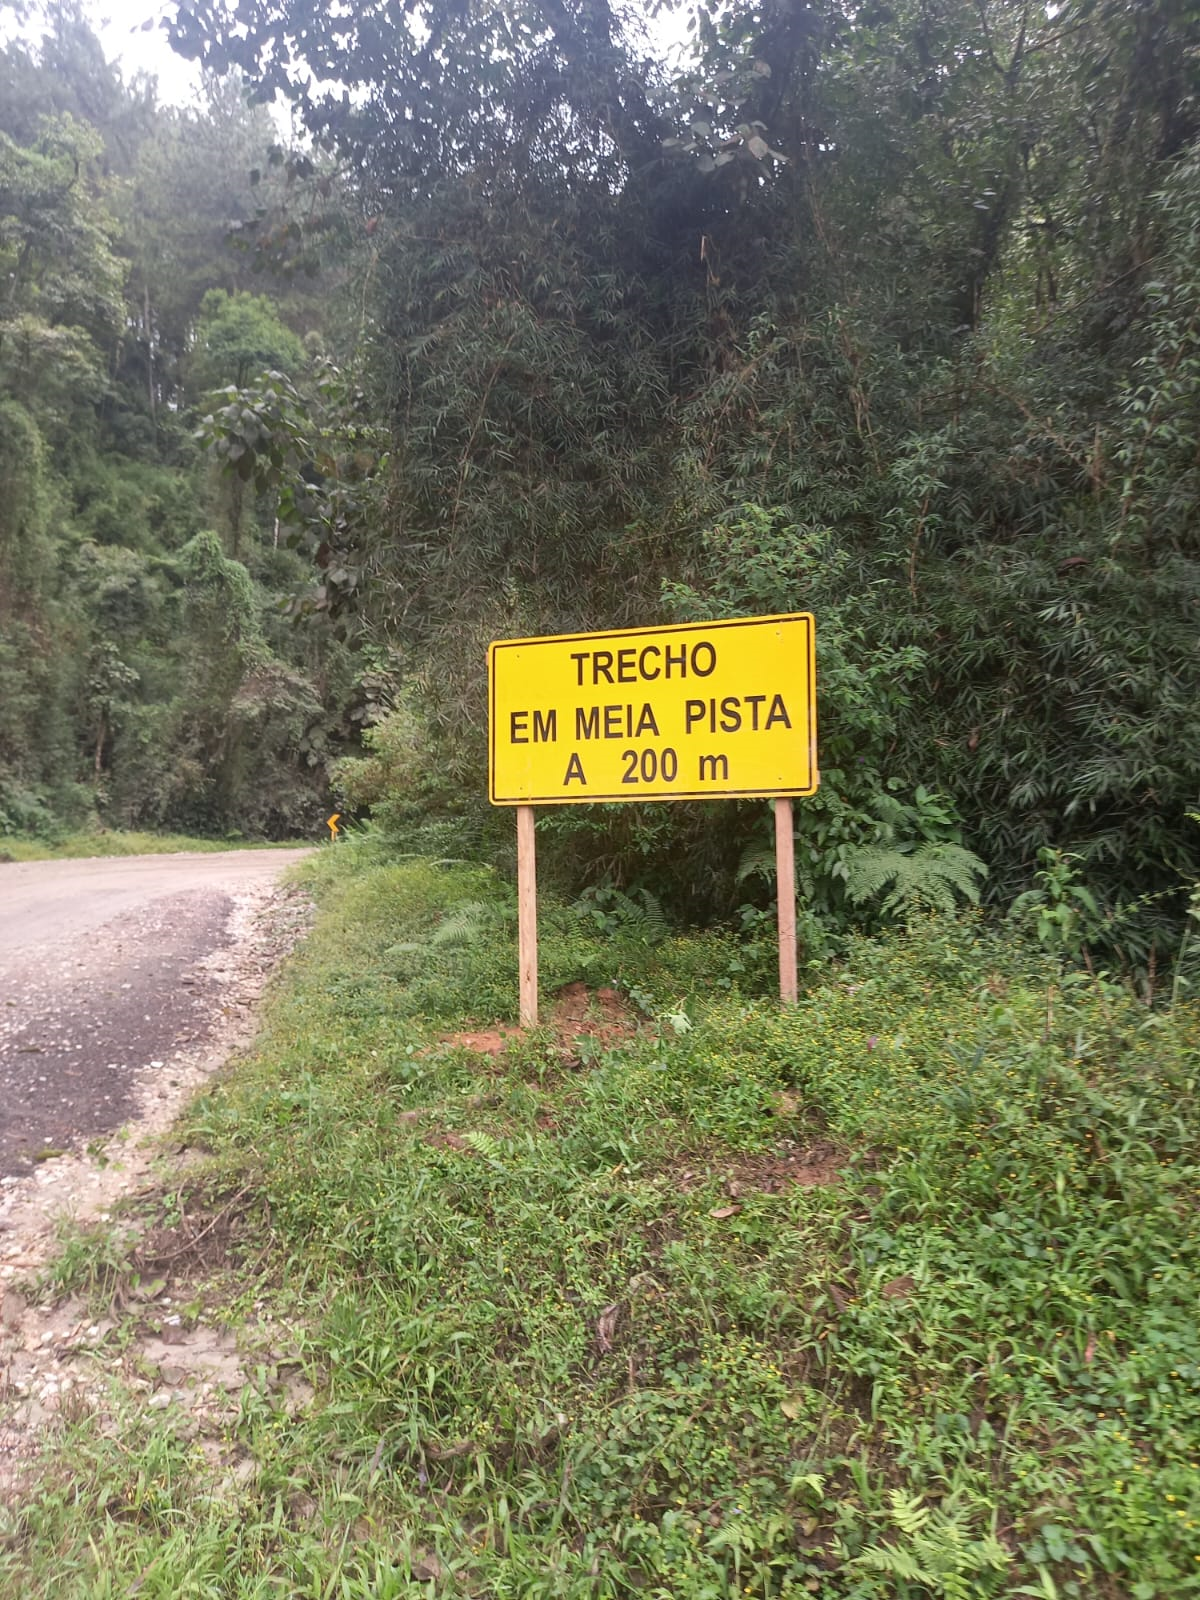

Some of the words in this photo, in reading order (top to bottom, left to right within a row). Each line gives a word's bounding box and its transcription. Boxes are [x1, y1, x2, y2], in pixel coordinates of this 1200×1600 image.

[570, 641, 717, 686] TRECHO
[510, 709, 557, 744] EM
[575, 703, 660, 740] MEIA
[685, 693, 792, 734] PISTA
[563, 752, 587, 785] A
[621, 747, 678, 783] 200
[699, 753, 728, 781] m
